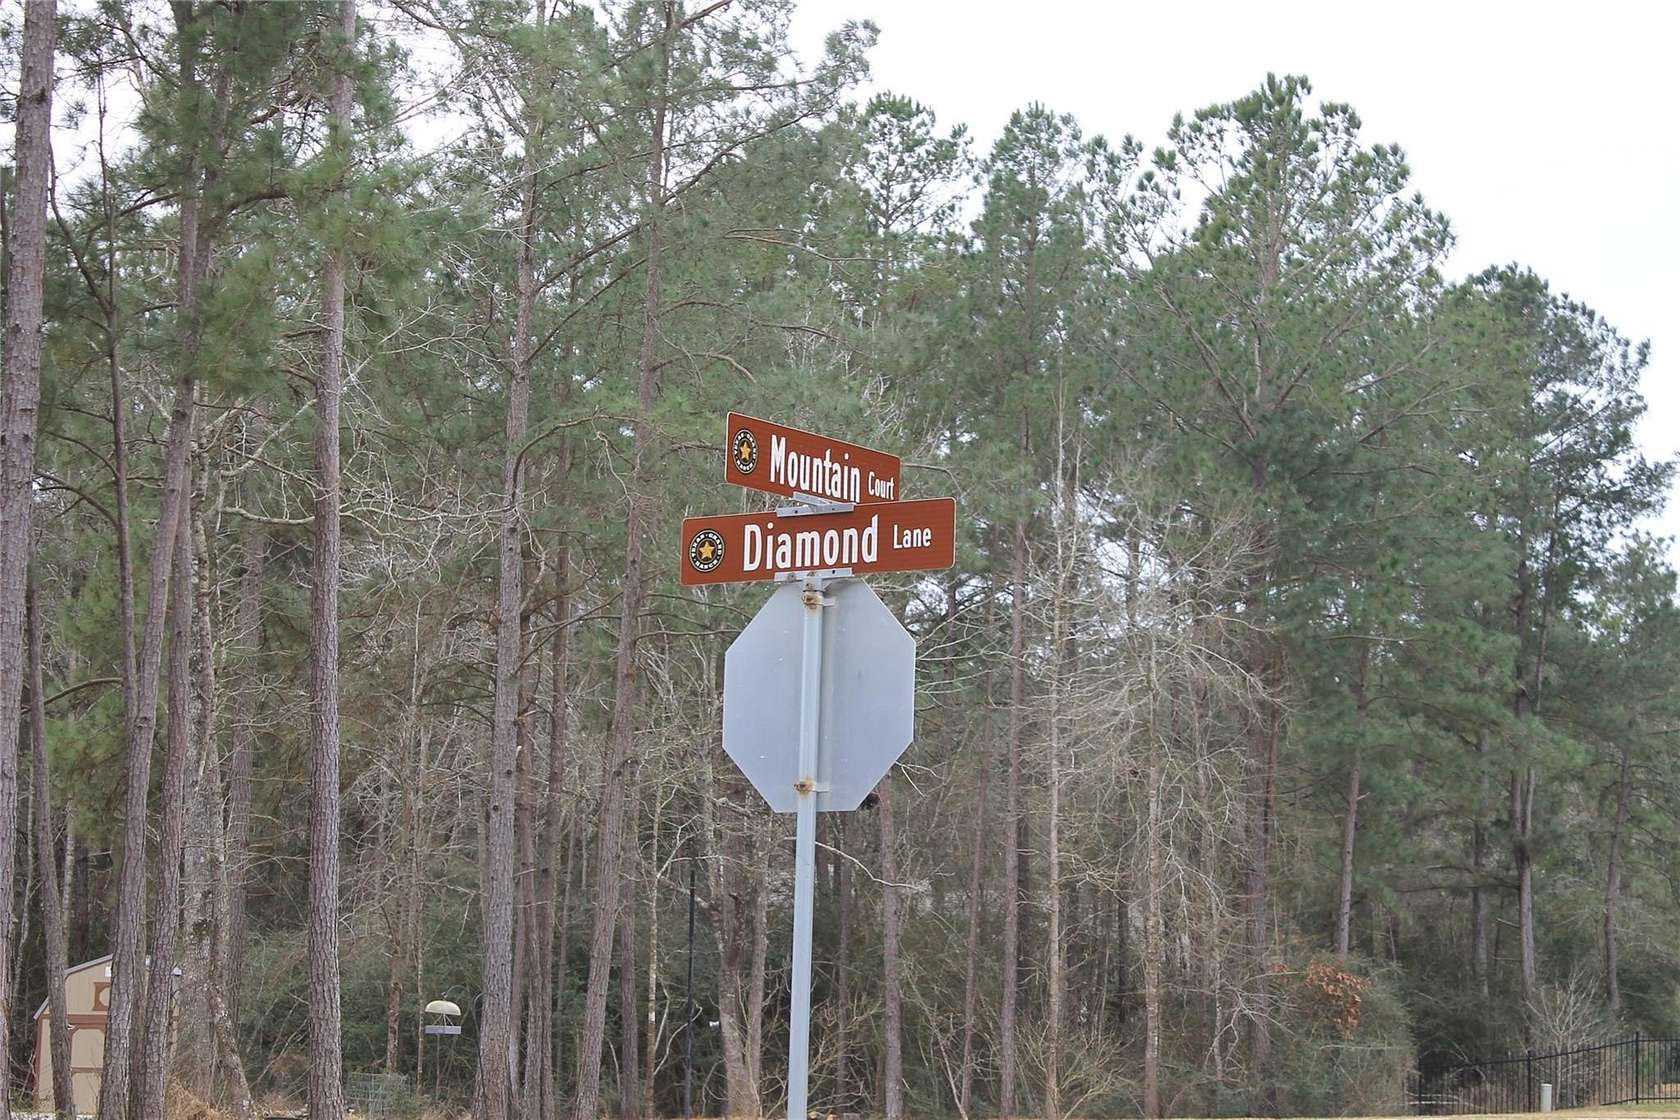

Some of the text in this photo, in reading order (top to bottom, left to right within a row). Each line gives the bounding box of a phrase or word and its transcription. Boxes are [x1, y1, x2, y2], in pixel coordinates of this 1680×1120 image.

[770, 434, 895, 503] Mountain Court
[743, 514, 932, 572] Diamond Lane
